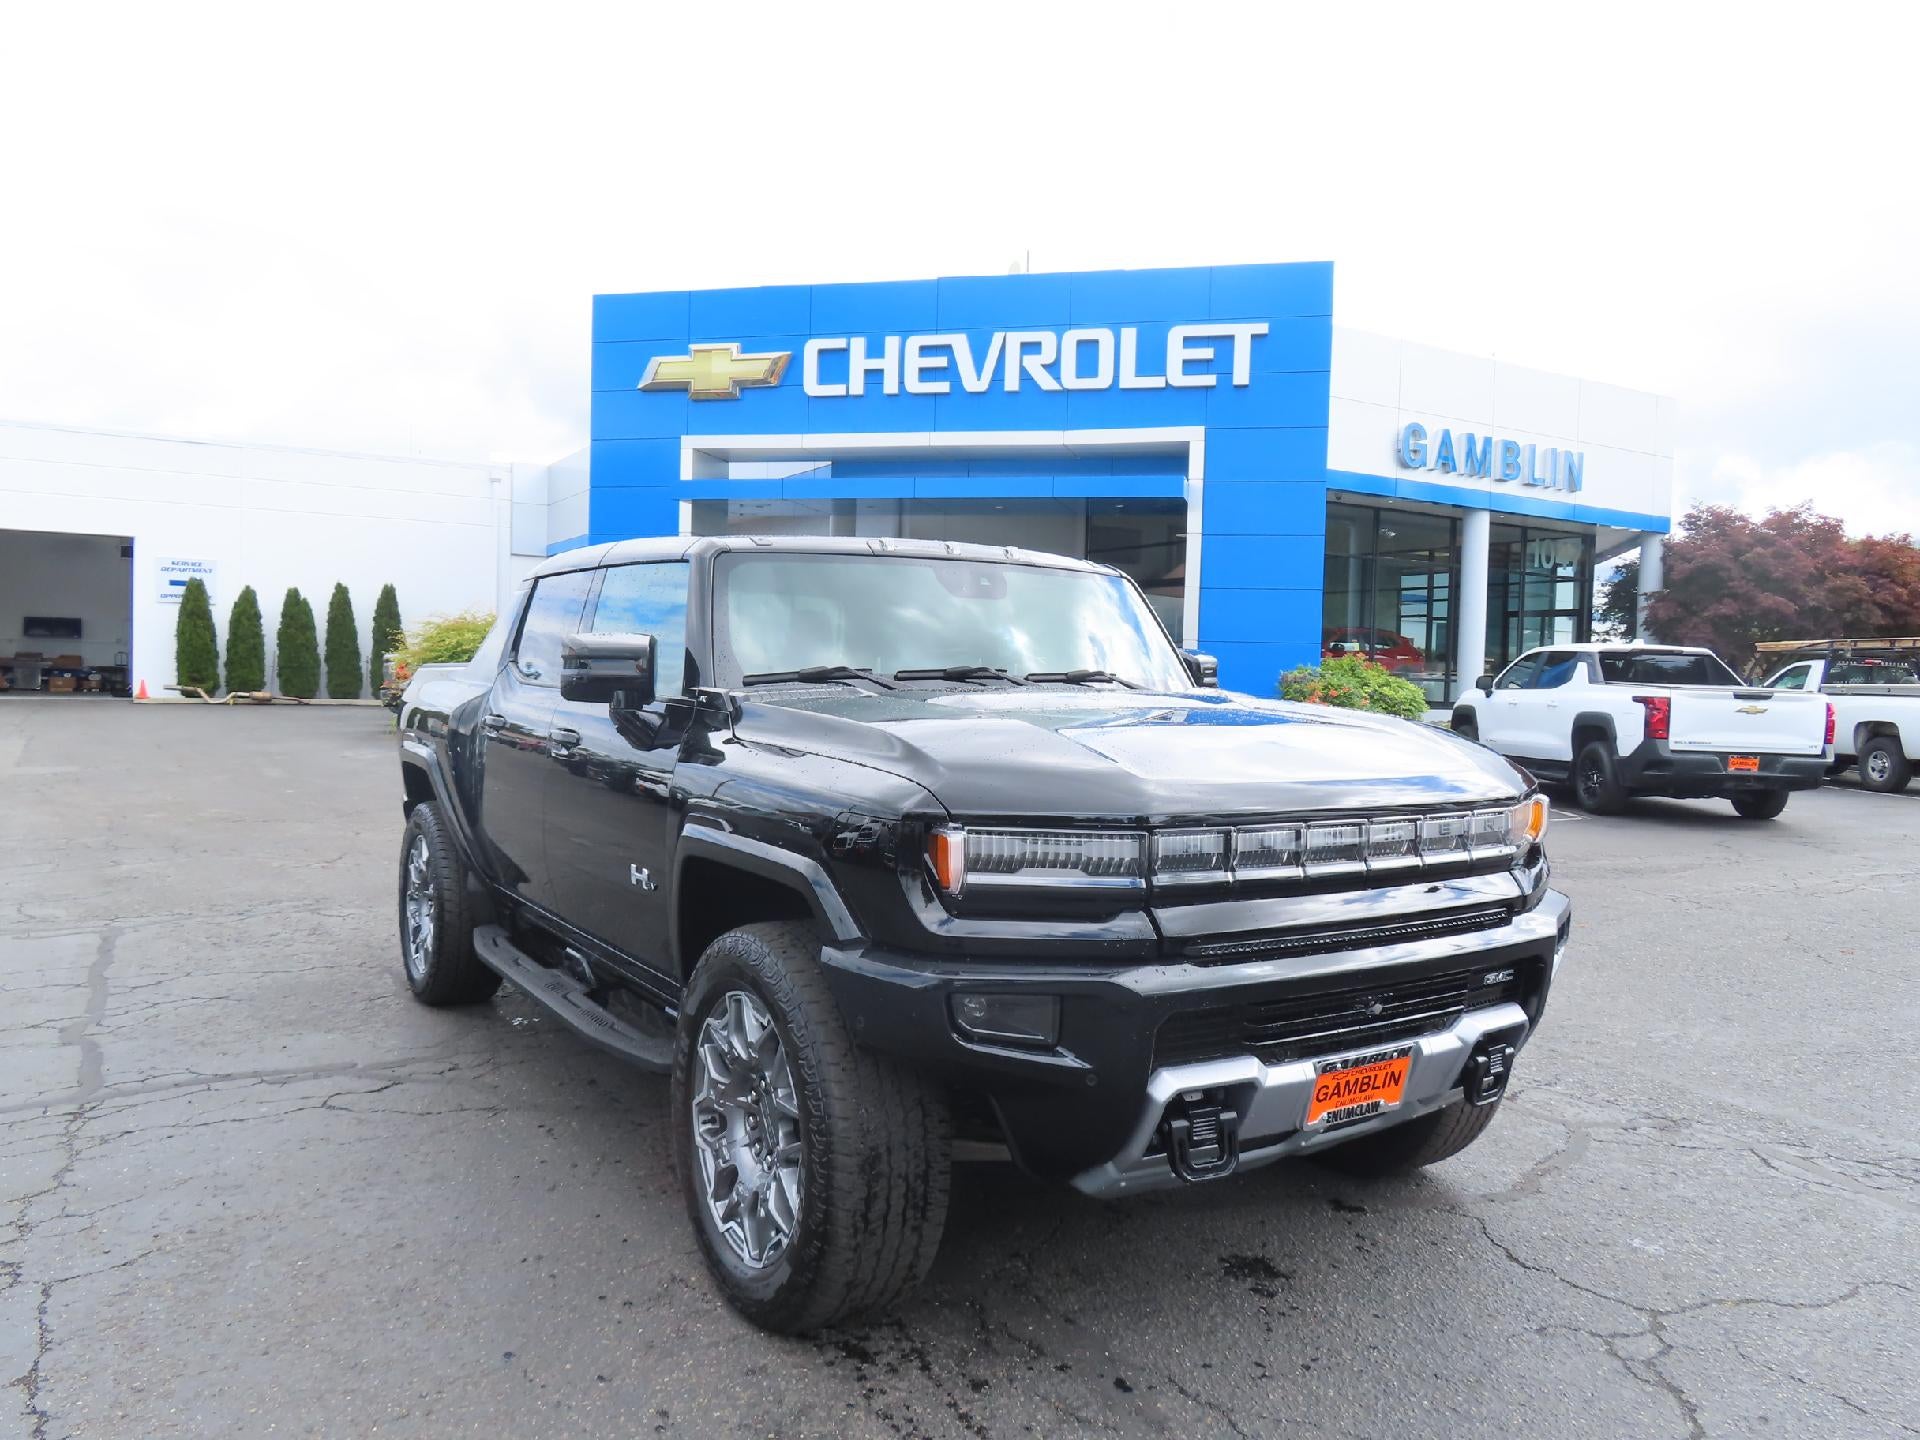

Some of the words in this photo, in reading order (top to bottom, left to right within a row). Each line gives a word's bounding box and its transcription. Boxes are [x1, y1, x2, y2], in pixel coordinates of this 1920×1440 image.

[802, 322, 1269, 397] CHEVROLET
[1399, 422, 1584, 493] GAMBLIN
[1350, 1063, 1393, 1076] CHEVROLET
[1316, 1070, 1402, 1103] GAMBLIN
[1326, 1101, 1380, 1123] ENUMCLAW
[1335, 1094, 1374, 1107] ENUMCLAW
